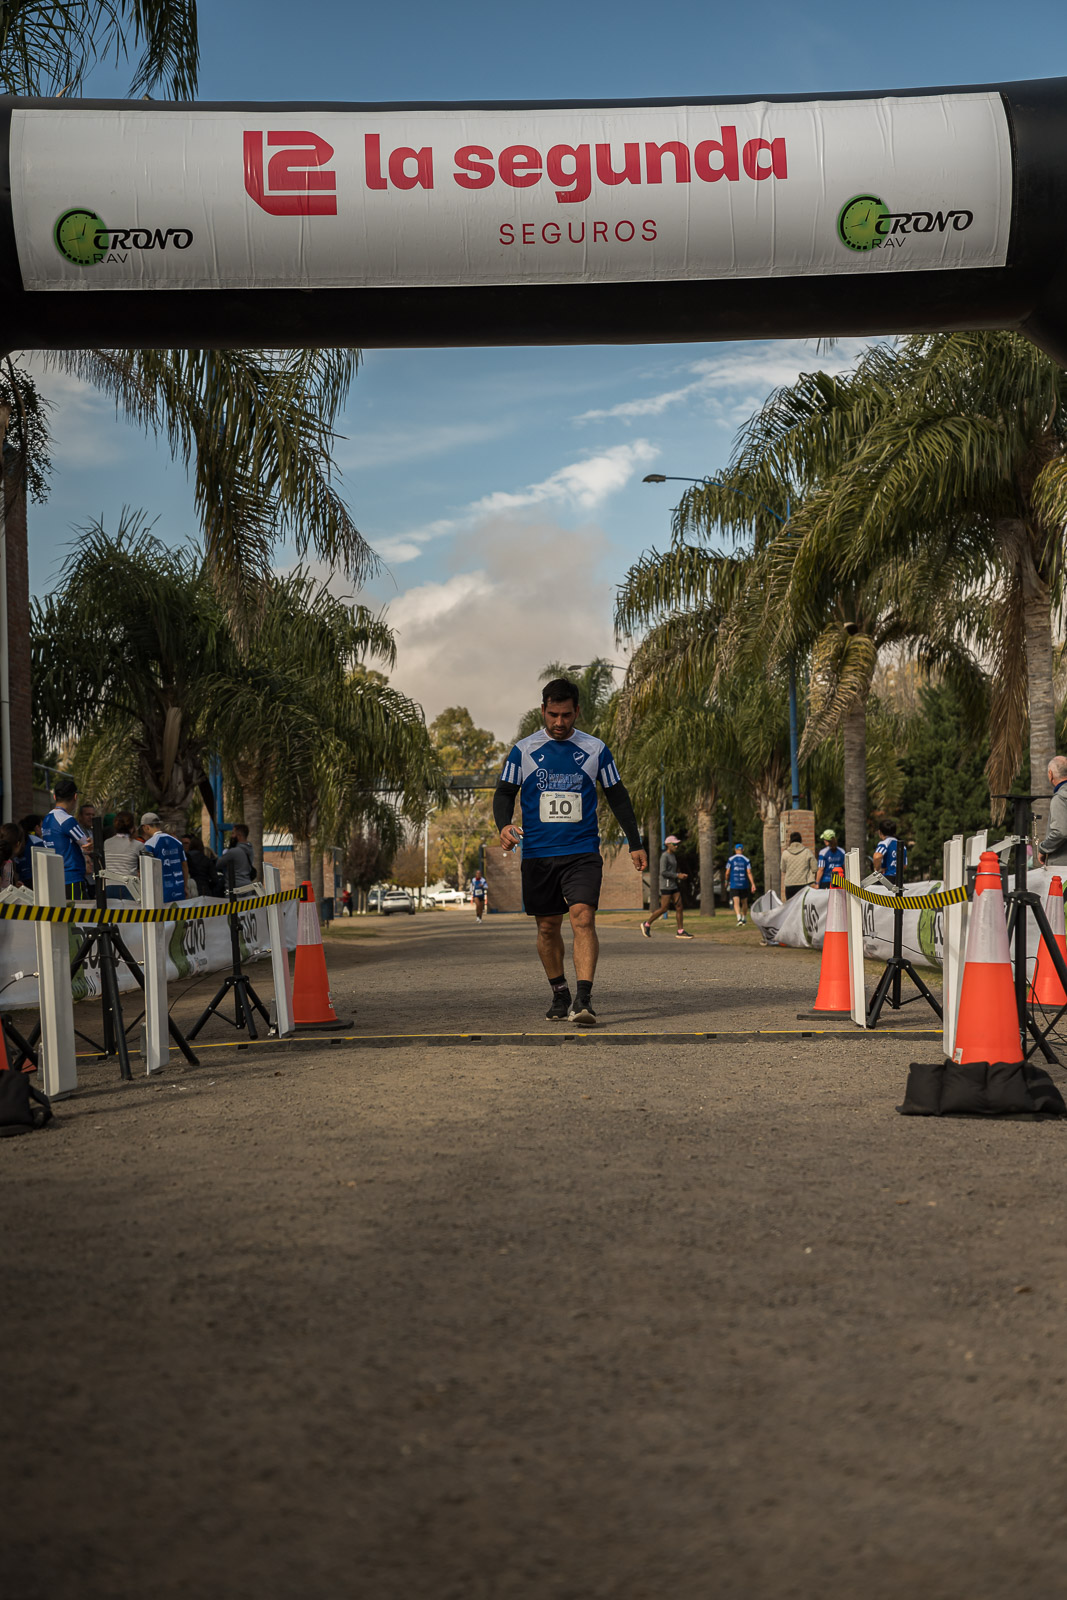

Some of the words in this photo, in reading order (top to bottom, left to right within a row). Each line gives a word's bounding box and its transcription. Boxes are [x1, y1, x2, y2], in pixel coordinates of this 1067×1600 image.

[365, 134, 433, 190] la
[453, 126, 788, 204] segunda
[499, 219, 658, 245] SEGUROS
[875, 209, 974, 235] CRONO
[94, 228, 193, 250] CRONO
[871, 237, 907, 249] RAV
[92, 253, 129, 264] RAV
[537, 769, 548, 791] 3
[549, 800, 572, 815] 10
